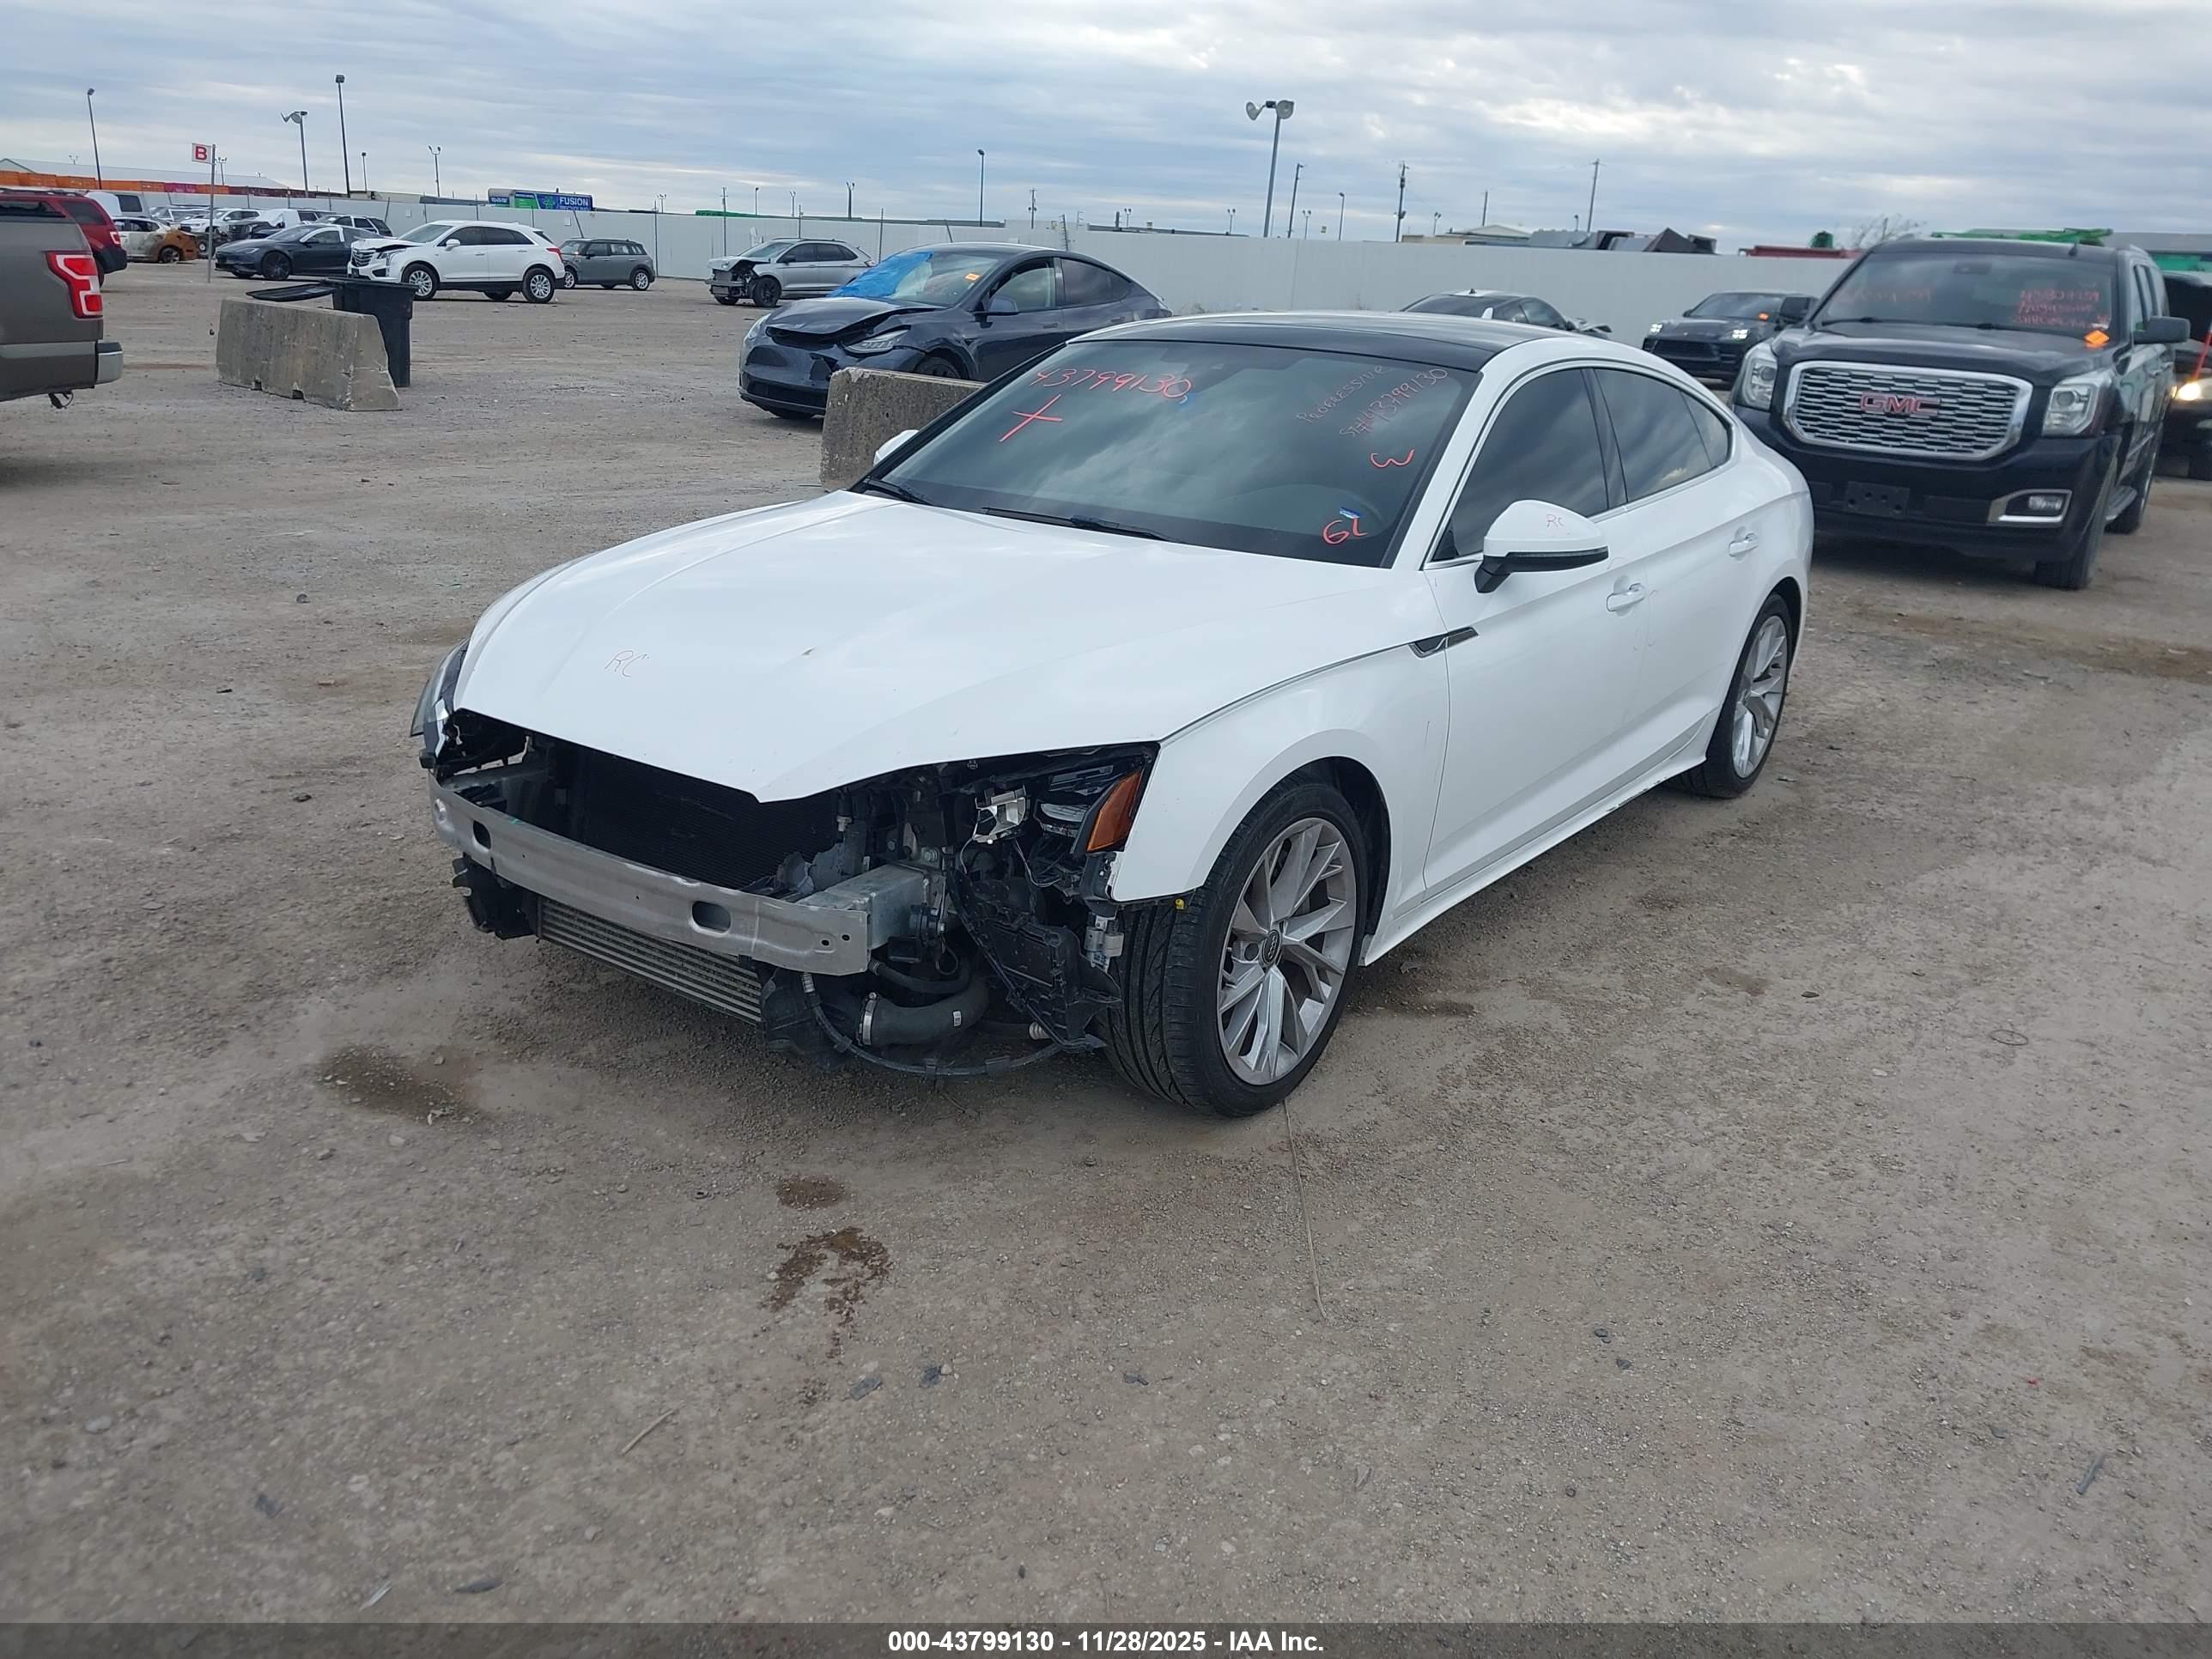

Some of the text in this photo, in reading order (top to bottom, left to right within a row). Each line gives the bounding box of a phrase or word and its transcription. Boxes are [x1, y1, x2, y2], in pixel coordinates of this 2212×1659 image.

[196, 146, 207, 161] B
[559, 197, 588, 206] FUSION
[1030, 368, 1191, 398] 43799130
[1860, 391, 1940, 416] GMC
